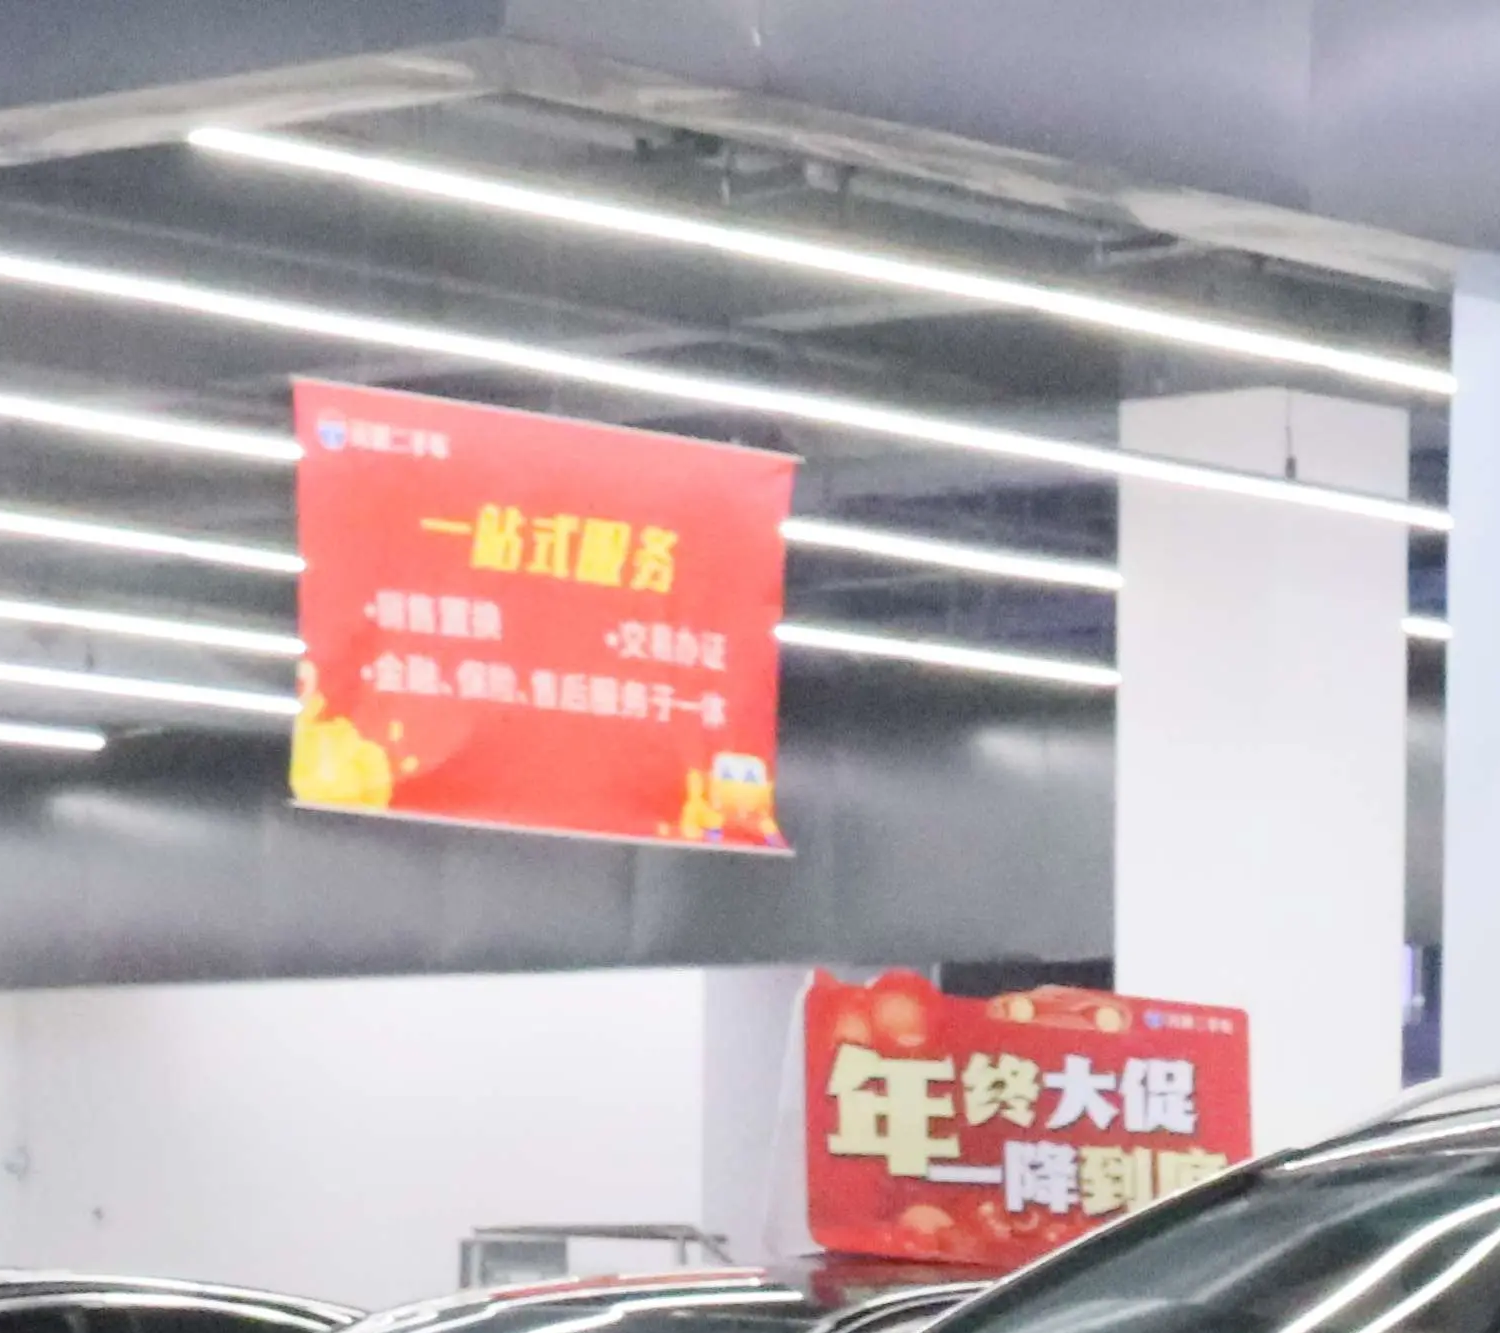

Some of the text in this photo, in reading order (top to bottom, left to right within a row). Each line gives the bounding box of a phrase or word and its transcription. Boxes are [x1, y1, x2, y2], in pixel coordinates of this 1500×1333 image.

[418, 503, 679, 594] 一站式服务
[826, 1042, 1199, 1178] 年终大促
